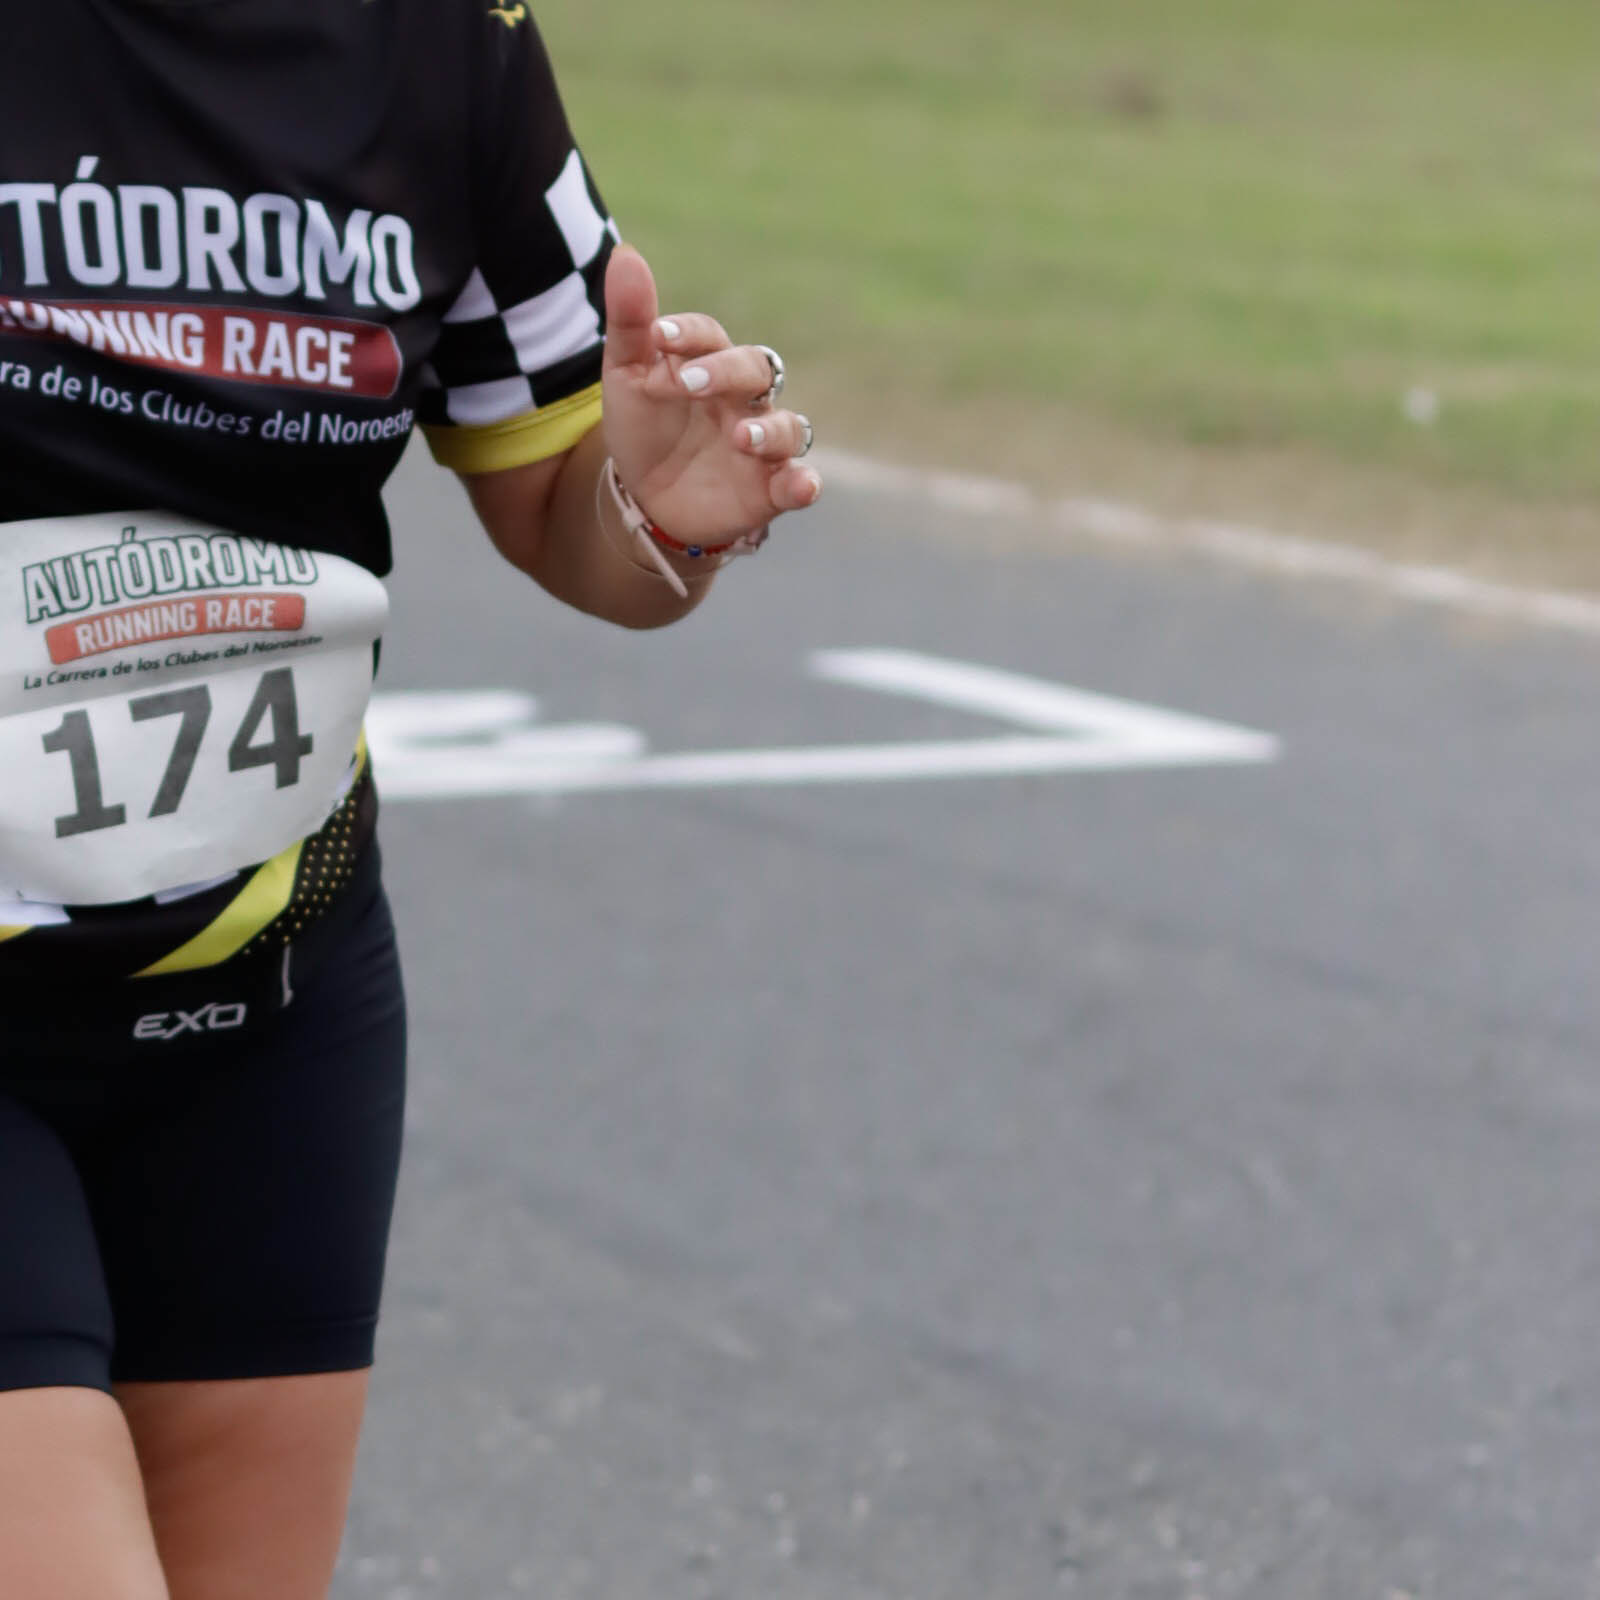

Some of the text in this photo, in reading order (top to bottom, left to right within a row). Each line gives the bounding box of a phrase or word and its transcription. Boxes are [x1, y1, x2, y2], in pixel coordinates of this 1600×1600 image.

[222, 315, 356, 389] RACE
[40, 364, 82, 400] de
[90, 375, 135, 414] los
[141, 389, 252, 435] Clubes
[260, 410, 311, 443] del
[21, 526, 319, 625] AUTÓDROMO
[73, 598, 277, 656] RUNNING RACE
[23, 675, 42, 691] La
[46, 668, 108, 687] Carrera
[111, 660, 133, 677] de
[136, 656, 161, 673] los
[164, 648, 220, 668] Clubes
[223, 641, 250, 659] del
[41, 666, 314, 839] 174
[132, 1001, 247, 1040] EXO
